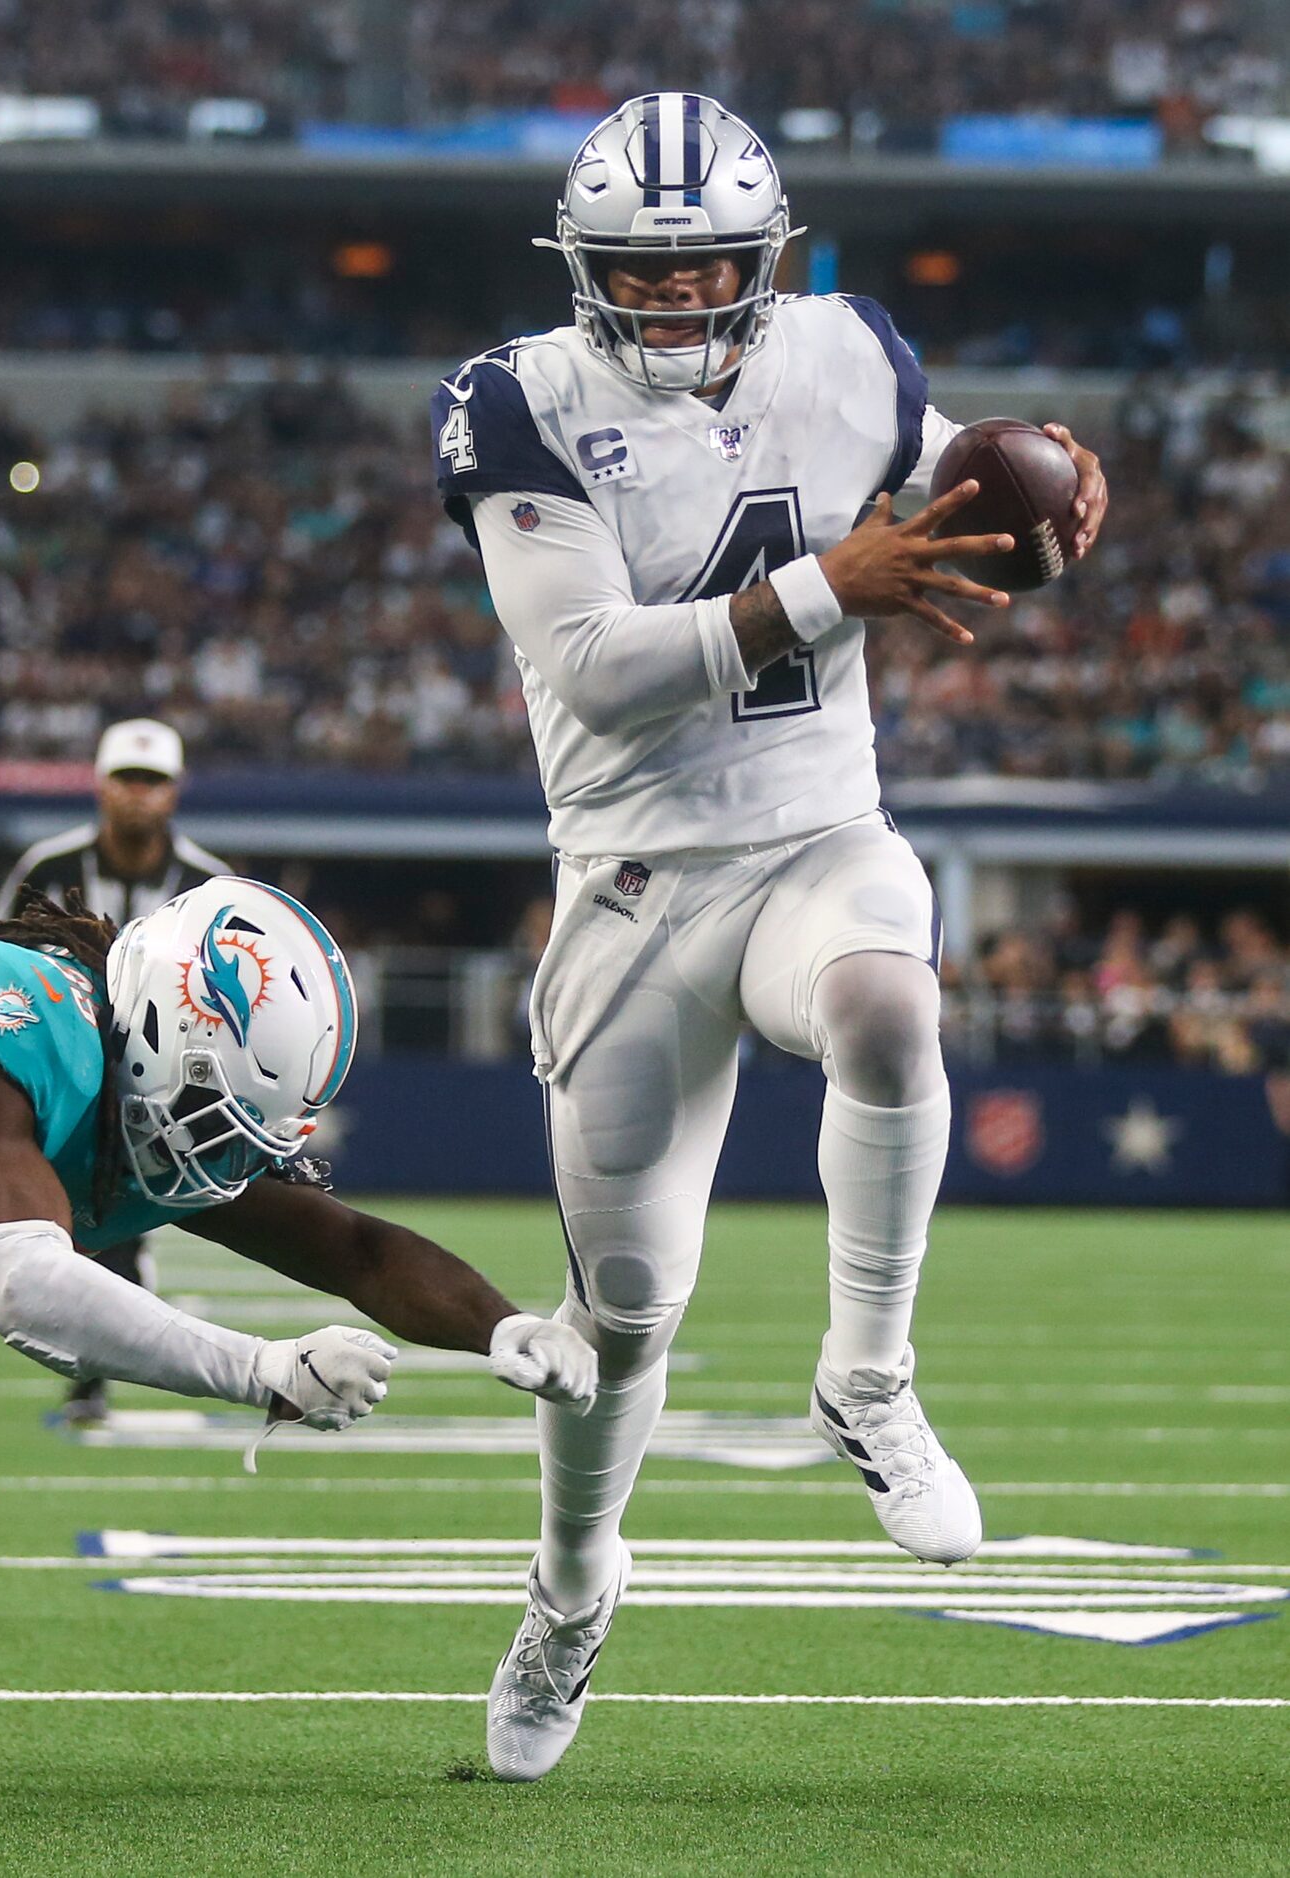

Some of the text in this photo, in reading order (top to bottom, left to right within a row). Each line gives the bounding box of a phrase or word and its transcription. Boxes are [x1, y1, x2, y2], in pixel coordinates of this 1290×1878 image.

[653, 217, 692, 225] COWBOYS
[439, 402, 478, 474] 4
[576, 427, 628, 472] C
[516, 511, 540, 529] NFL
[672, 486, 822, 723] 4
[616, 871, 644, 893] NFL
